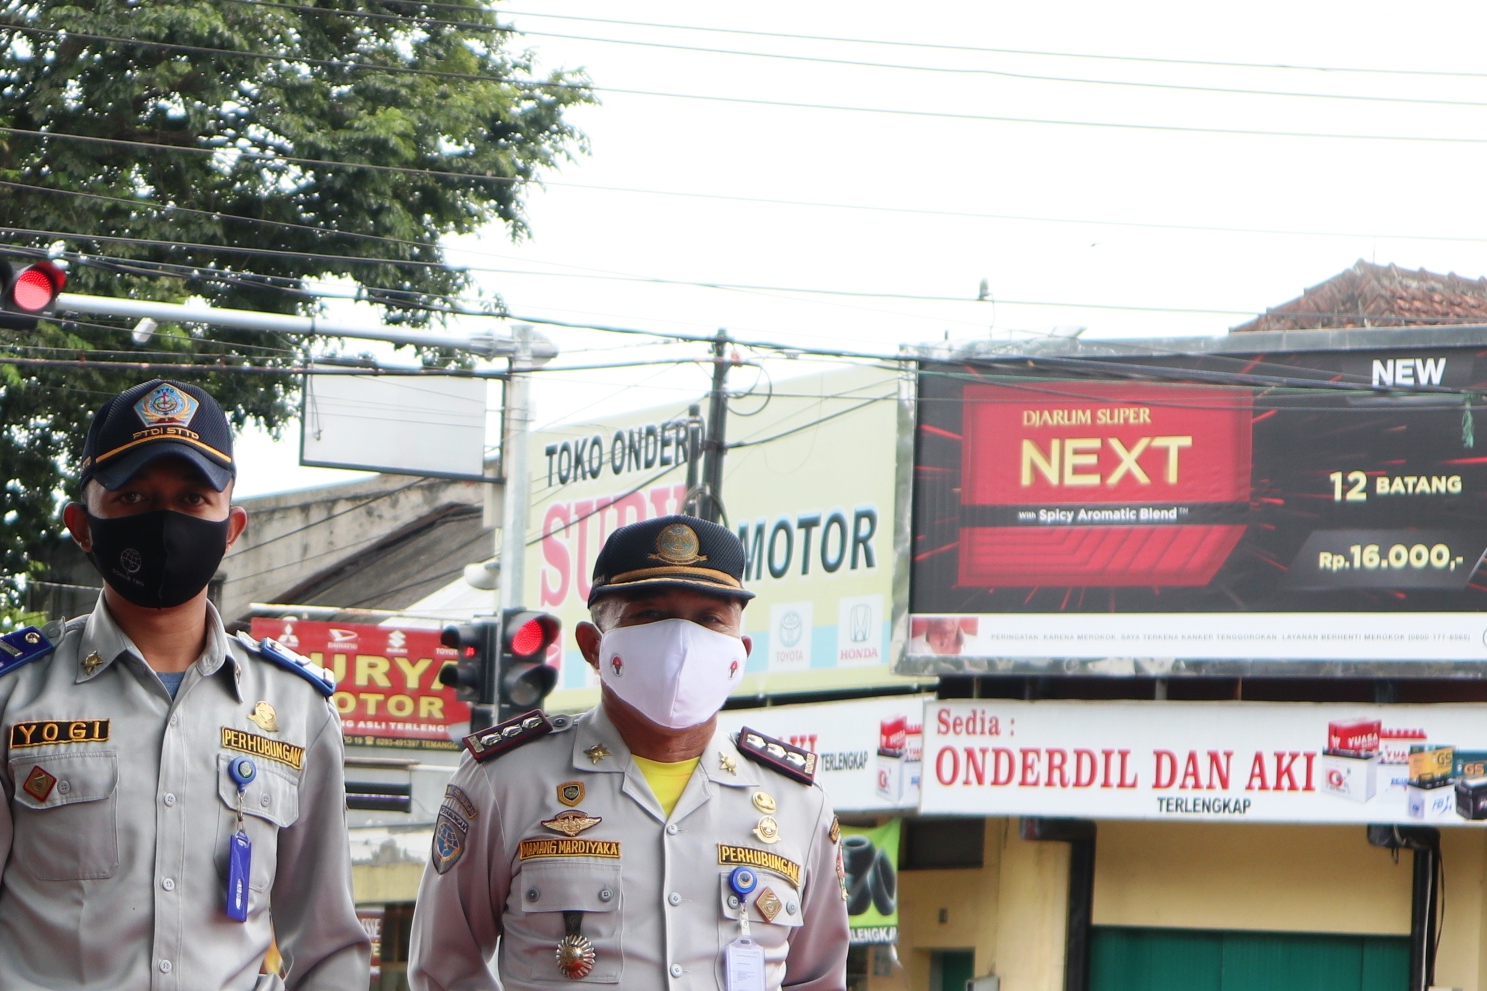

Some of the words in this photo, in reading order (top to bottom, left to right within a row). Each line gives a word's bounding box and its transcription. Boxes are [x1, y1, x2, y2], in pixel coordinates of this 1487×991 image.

[1372, 357, 1446, 388] NEW
[1022, 407, 1092, 427] DJARUM
[1096, 406, 1152, 425] SUPER
[132, 427, 163, 440] PTDI
[544, 433, 603, 488] TOKO
[1021, 435, 1193, 487] NEXT
[1329, 470, 1367, 502] 12
[1376, 475, 1462, 496] BATANG
[1039, 506, 1075, 524] Spicy
[1077, 506, 1137, 523] Aromatic
[738, 507, 878, 582] MOTOR
[1319, 543, 1463, 573] Rp.16.000,-
[435, 647, 459, 655] TOYOT
[776, 649, 804, 662] TOYOTA
[839, 646, 879, 661] HONDA
[333, 691, 445, 720] OTOR
[18, 720, 101, 744] YOGI
[936, 708, 1001, 737] Sedia
[223, 729, 302, 769] PERHUBUNGAN
[820, 751, 869, 772] TERLENGKAP
[935, 746, 1139, 790] ONDERDIL
[1152, 748, 1234, 791] DAN
[1244, 750, 1317, 793] AKI
[1157, 797, 1252, 815] TERLENGKAP
[558, 840, 618, 855] MARDIYAKA
[721, 846, 800, 884] PERHUBUNGAN
